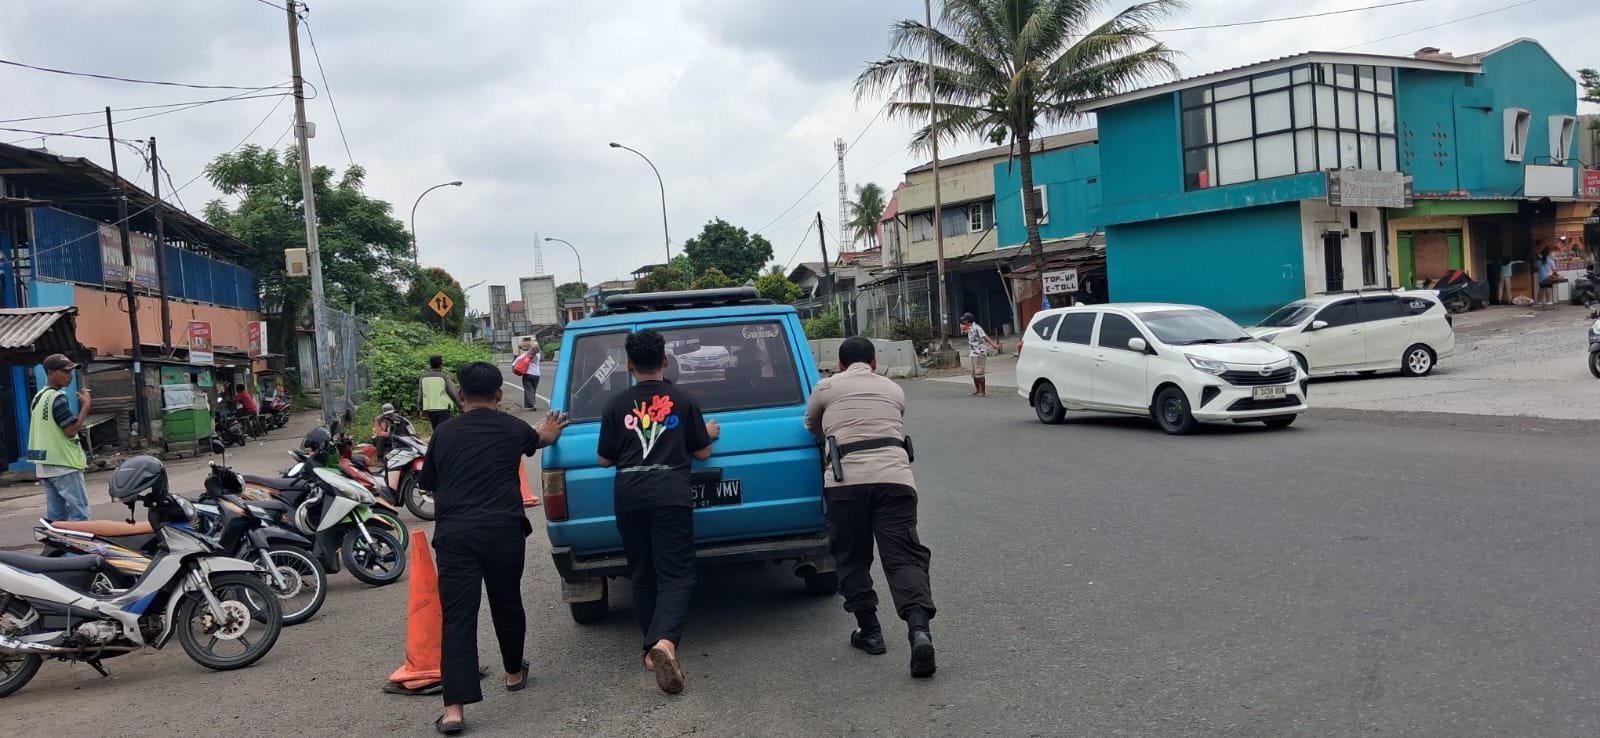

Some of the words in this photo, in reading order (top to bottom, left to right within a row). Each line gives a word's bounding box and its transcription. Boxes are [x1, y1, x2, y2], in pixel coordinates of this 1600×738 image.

[1044, 273, 1075, 283] TOP-UP
[1045, 283, 1076, 292] E-TOLL
[716, 480, 739, 497] VMV
